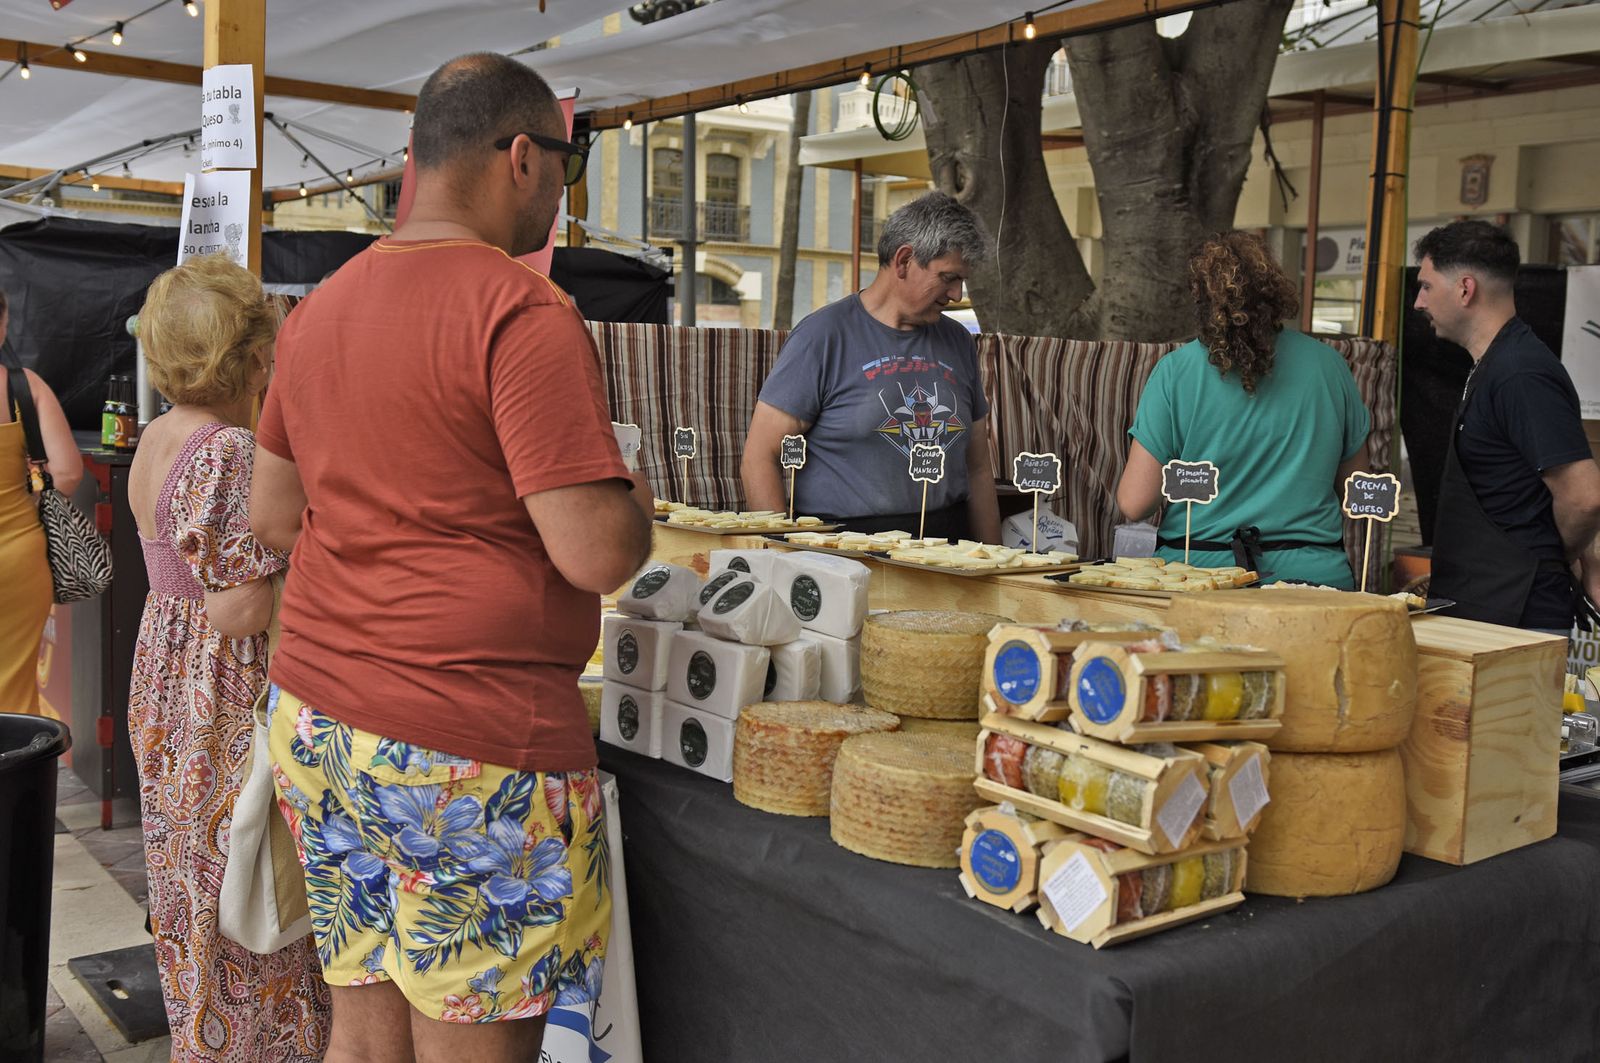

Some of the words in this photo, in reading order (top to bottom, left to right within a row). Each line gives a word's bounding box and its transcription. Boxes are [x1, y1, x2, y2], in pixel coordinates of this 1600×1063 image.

[213, 85, 242, 100] tabla
[233, 139, 243, 150] 4)
[218, 191, 228, 206] la
[1020, 477, 1051, 489] ACEITE
[1354, 479, 1388, 491] CREMA
[1363, 492, 1375, 500] DE
[1351, 502, 1383, 514] QUESO
[1567, 638, 1600, 661] WO
